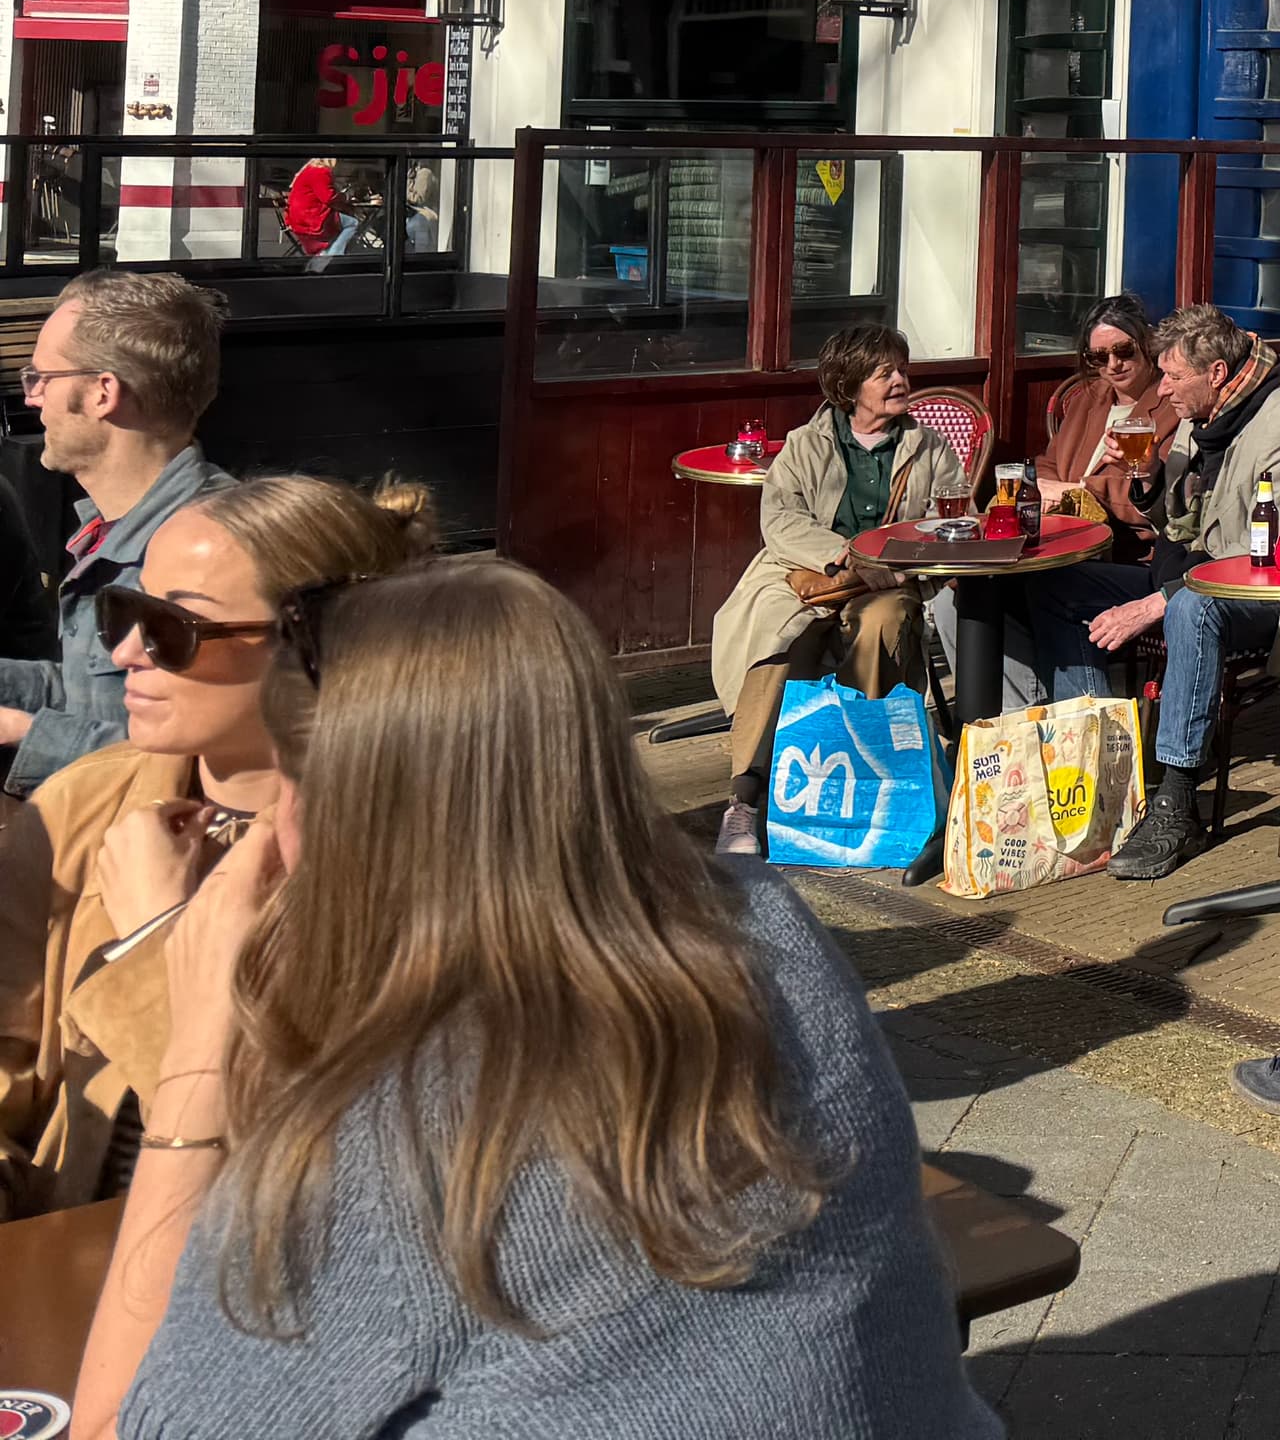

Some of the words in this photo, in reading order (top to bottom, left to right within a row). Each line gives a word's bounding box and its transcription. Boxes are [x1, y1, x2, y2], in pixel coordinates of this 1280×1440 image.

[1004, 838, 1027, 848] GOOD
[1001, 847, 1026, 859] VIBES
[998, 858, 1024, 869] ONLY
